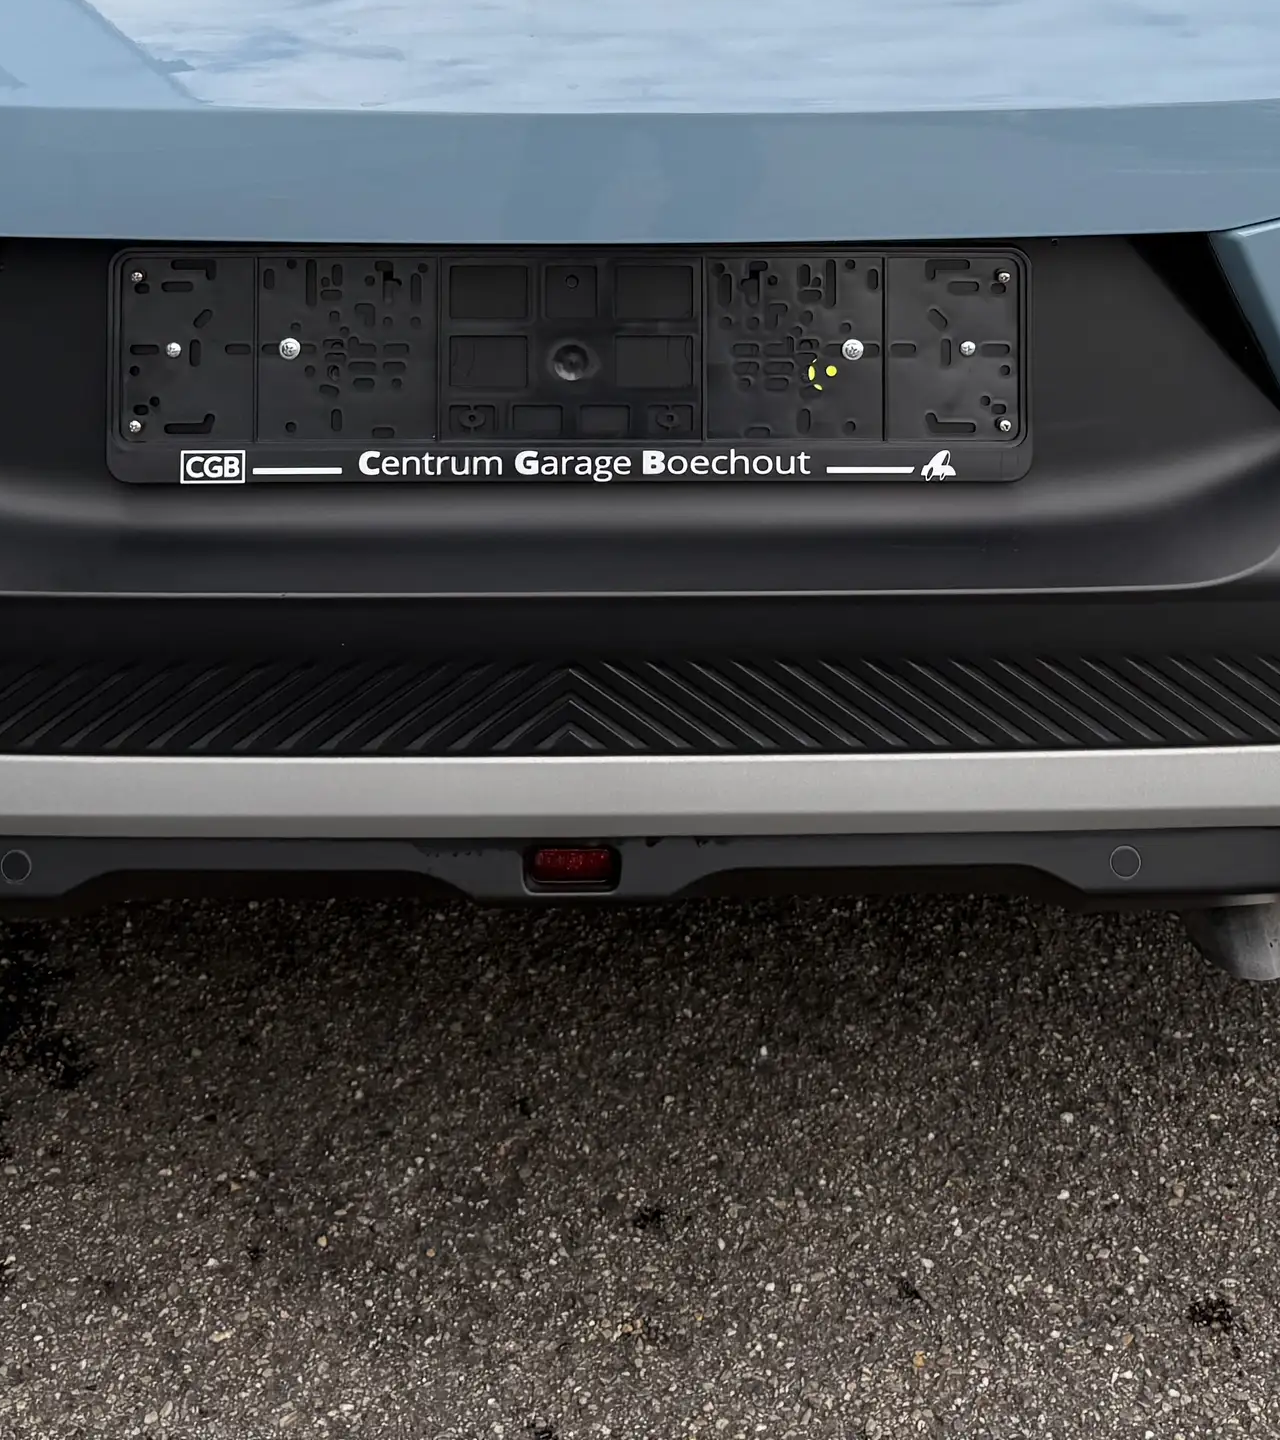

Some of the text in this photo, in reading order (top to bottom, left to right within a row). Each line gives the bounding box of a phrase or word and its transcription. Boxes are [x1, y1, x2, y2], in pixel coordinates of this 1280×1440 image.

[185, 448, 811, 482] CGB Centrum Garage Boechout
